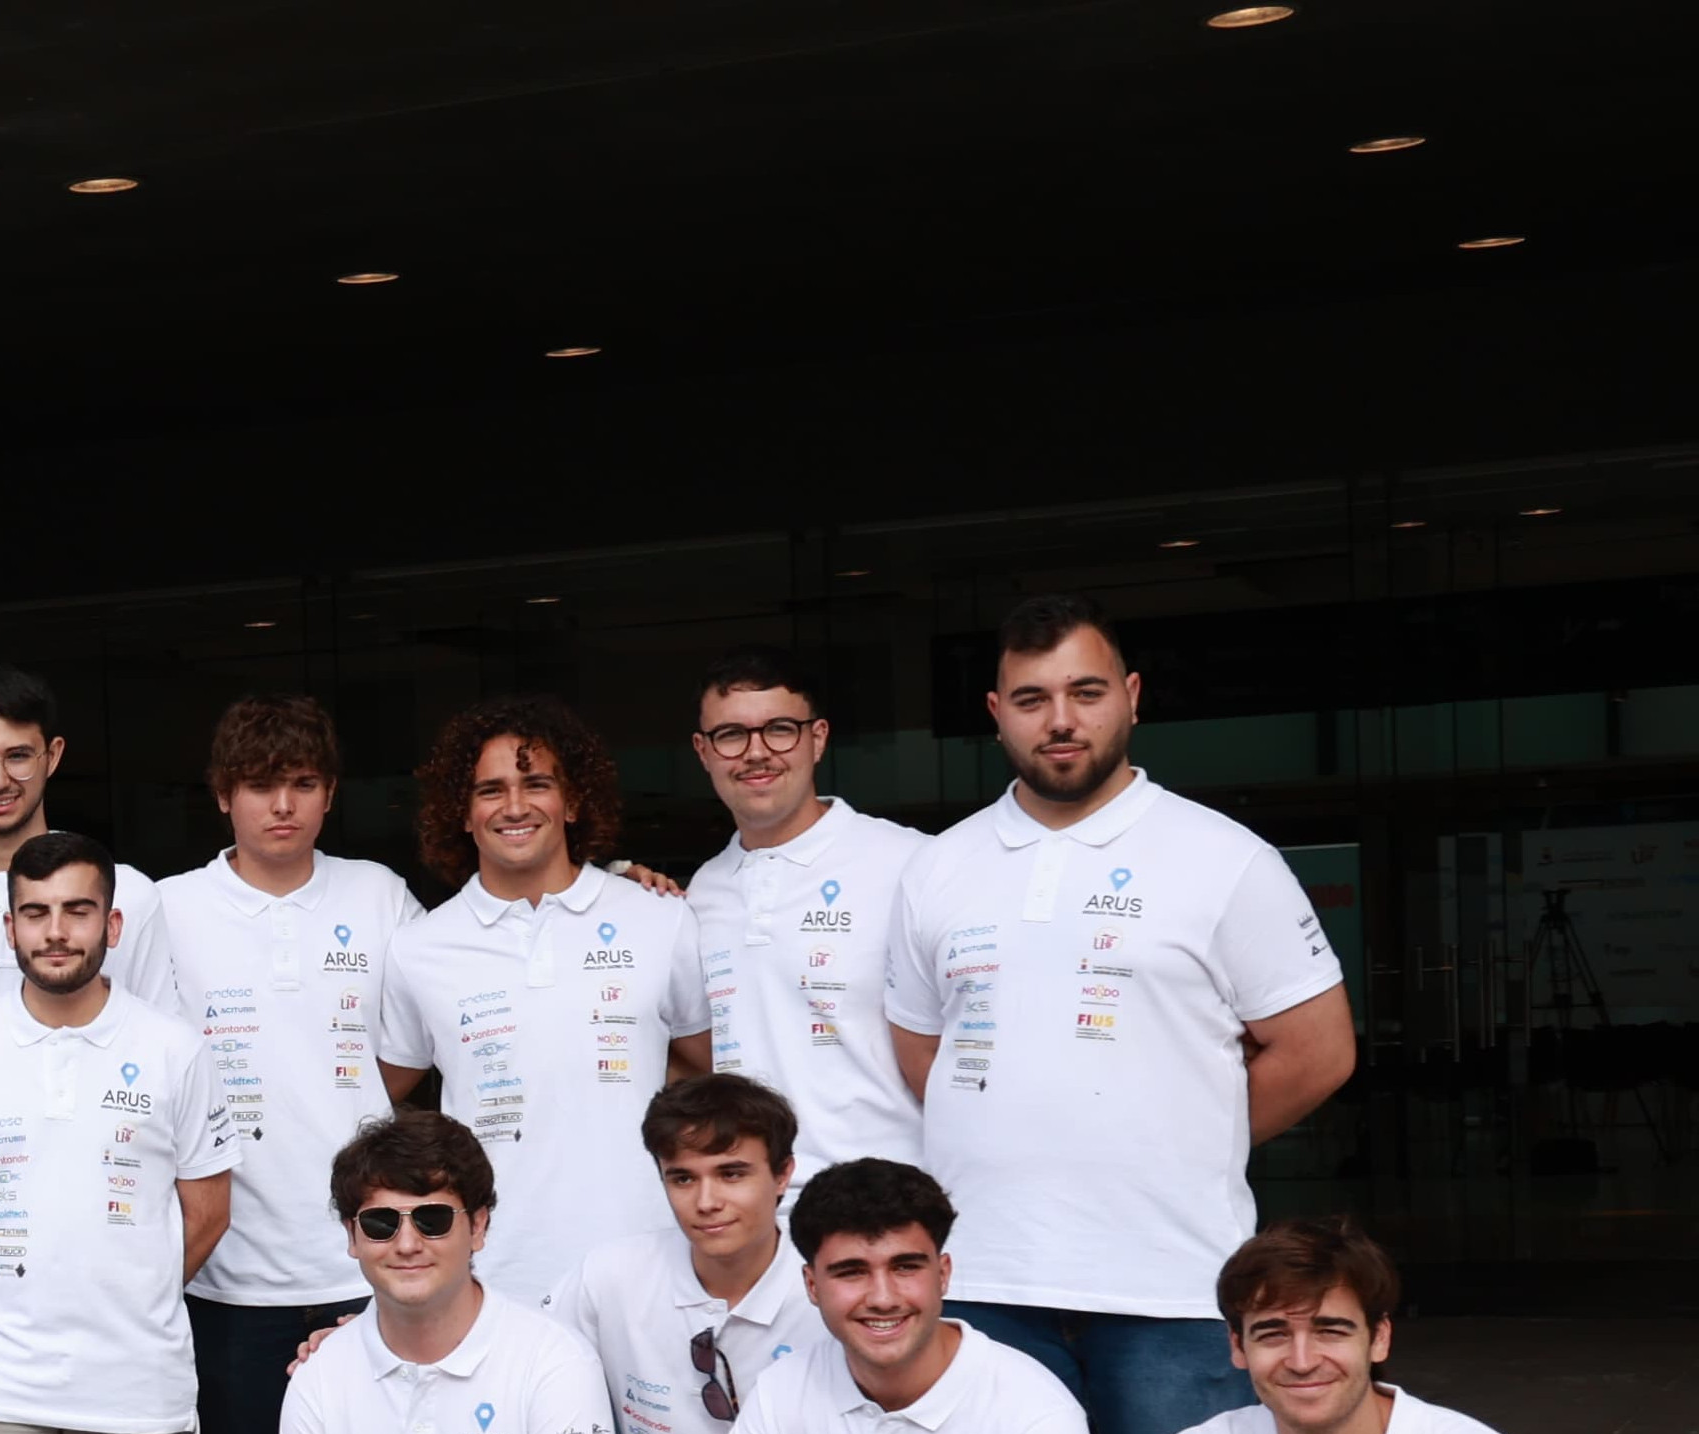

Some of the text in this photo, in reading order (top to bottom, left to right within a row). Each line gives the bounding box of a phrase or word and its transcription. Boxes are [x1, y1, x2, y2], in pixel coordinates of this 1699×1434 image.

[1085, 895, 1142, 912] ARUS
[801, 911, 852, 926] ARUS
[324, 952, 368, 968] ARUS
[584, 950, 633, 965] ARUS
[1077, 1014, 1114, 1027] FIUS
[213, 1025, 260, 1035] Santander
[471, 1024, 517, 1041] Santander
[217, 1057, 248, 1069] eks
[598, 1060, 628, 1070] FIUS
[103, 1090, 151, 1109] ARUS
